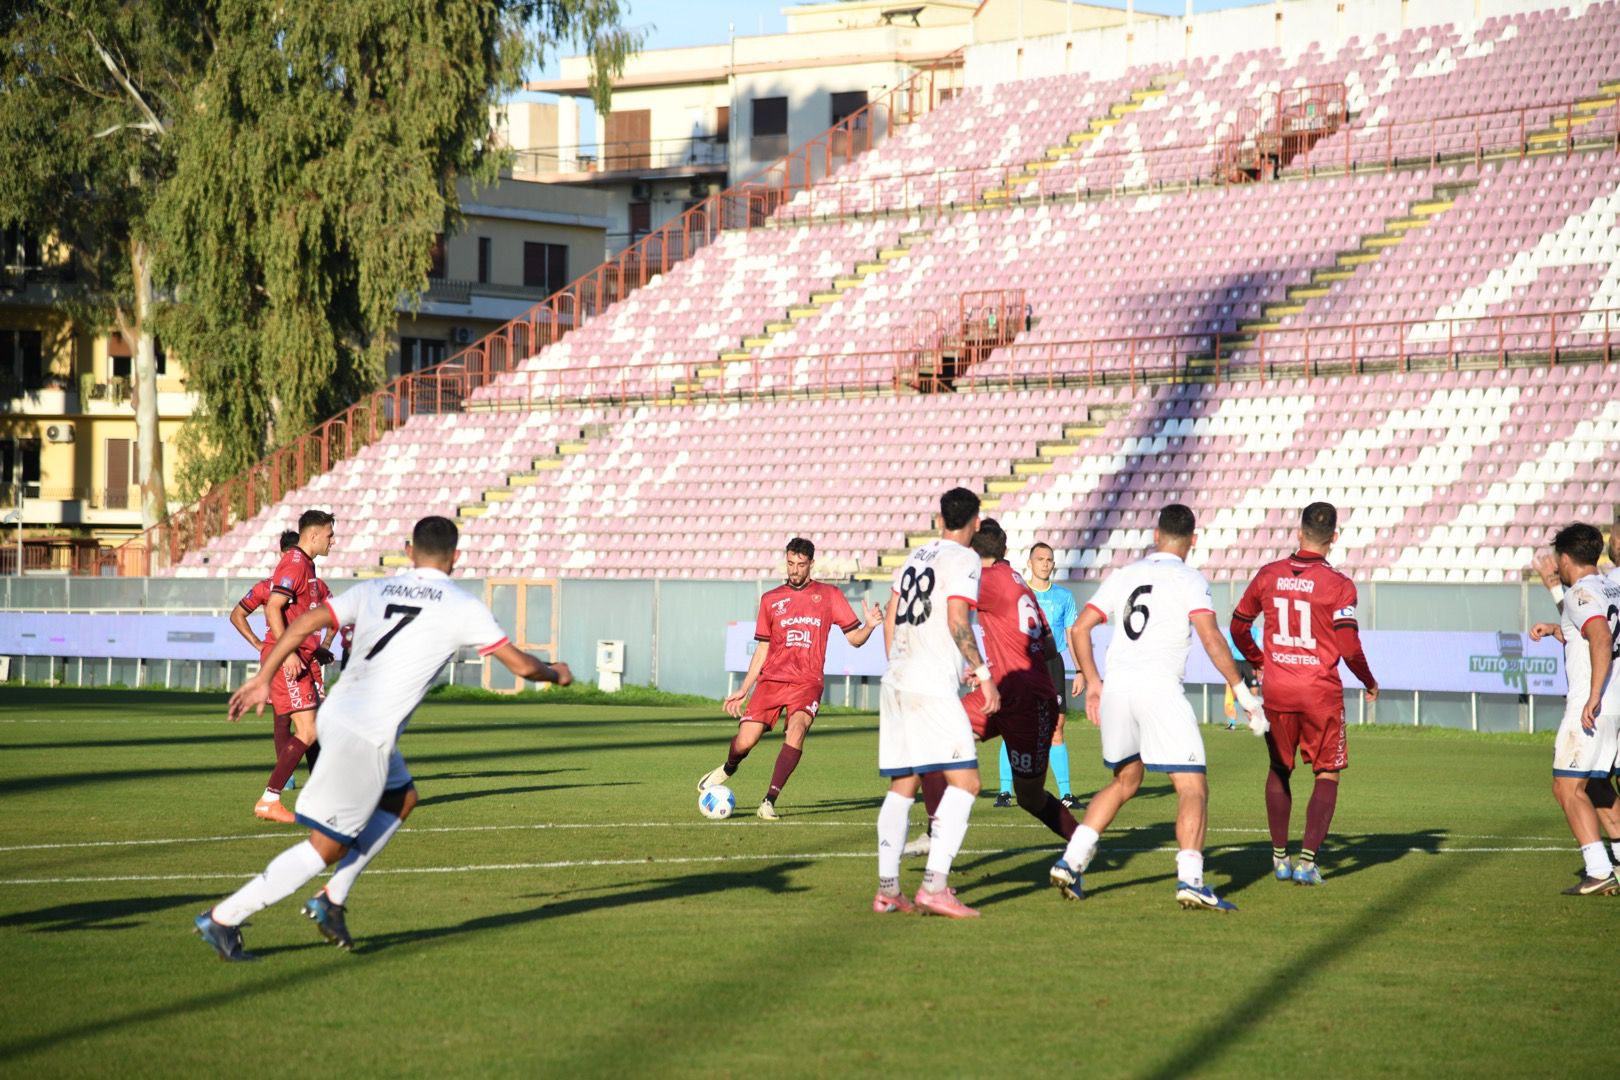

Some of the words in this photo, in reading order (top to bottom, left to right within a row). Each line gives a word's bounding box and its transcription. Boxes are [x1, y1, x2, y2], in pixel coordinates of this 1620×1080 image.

[381, 584, 443, 602] FRANCHINA
[1277, 577, 1315, 593] RAGUSA
[895, 565, 935, 627] 88
[1123, 584, 1153, 641] 6
[364, 603, 423, 661] 7
[1273, 597, 1317, 650] 11
[786, 630, 812, 644] EDIL
[1471, 657, 1507, 671] TUTTO
[1519, 658, 1555, 673] TUTTO
[1010, 750, 1032, 769] 68
